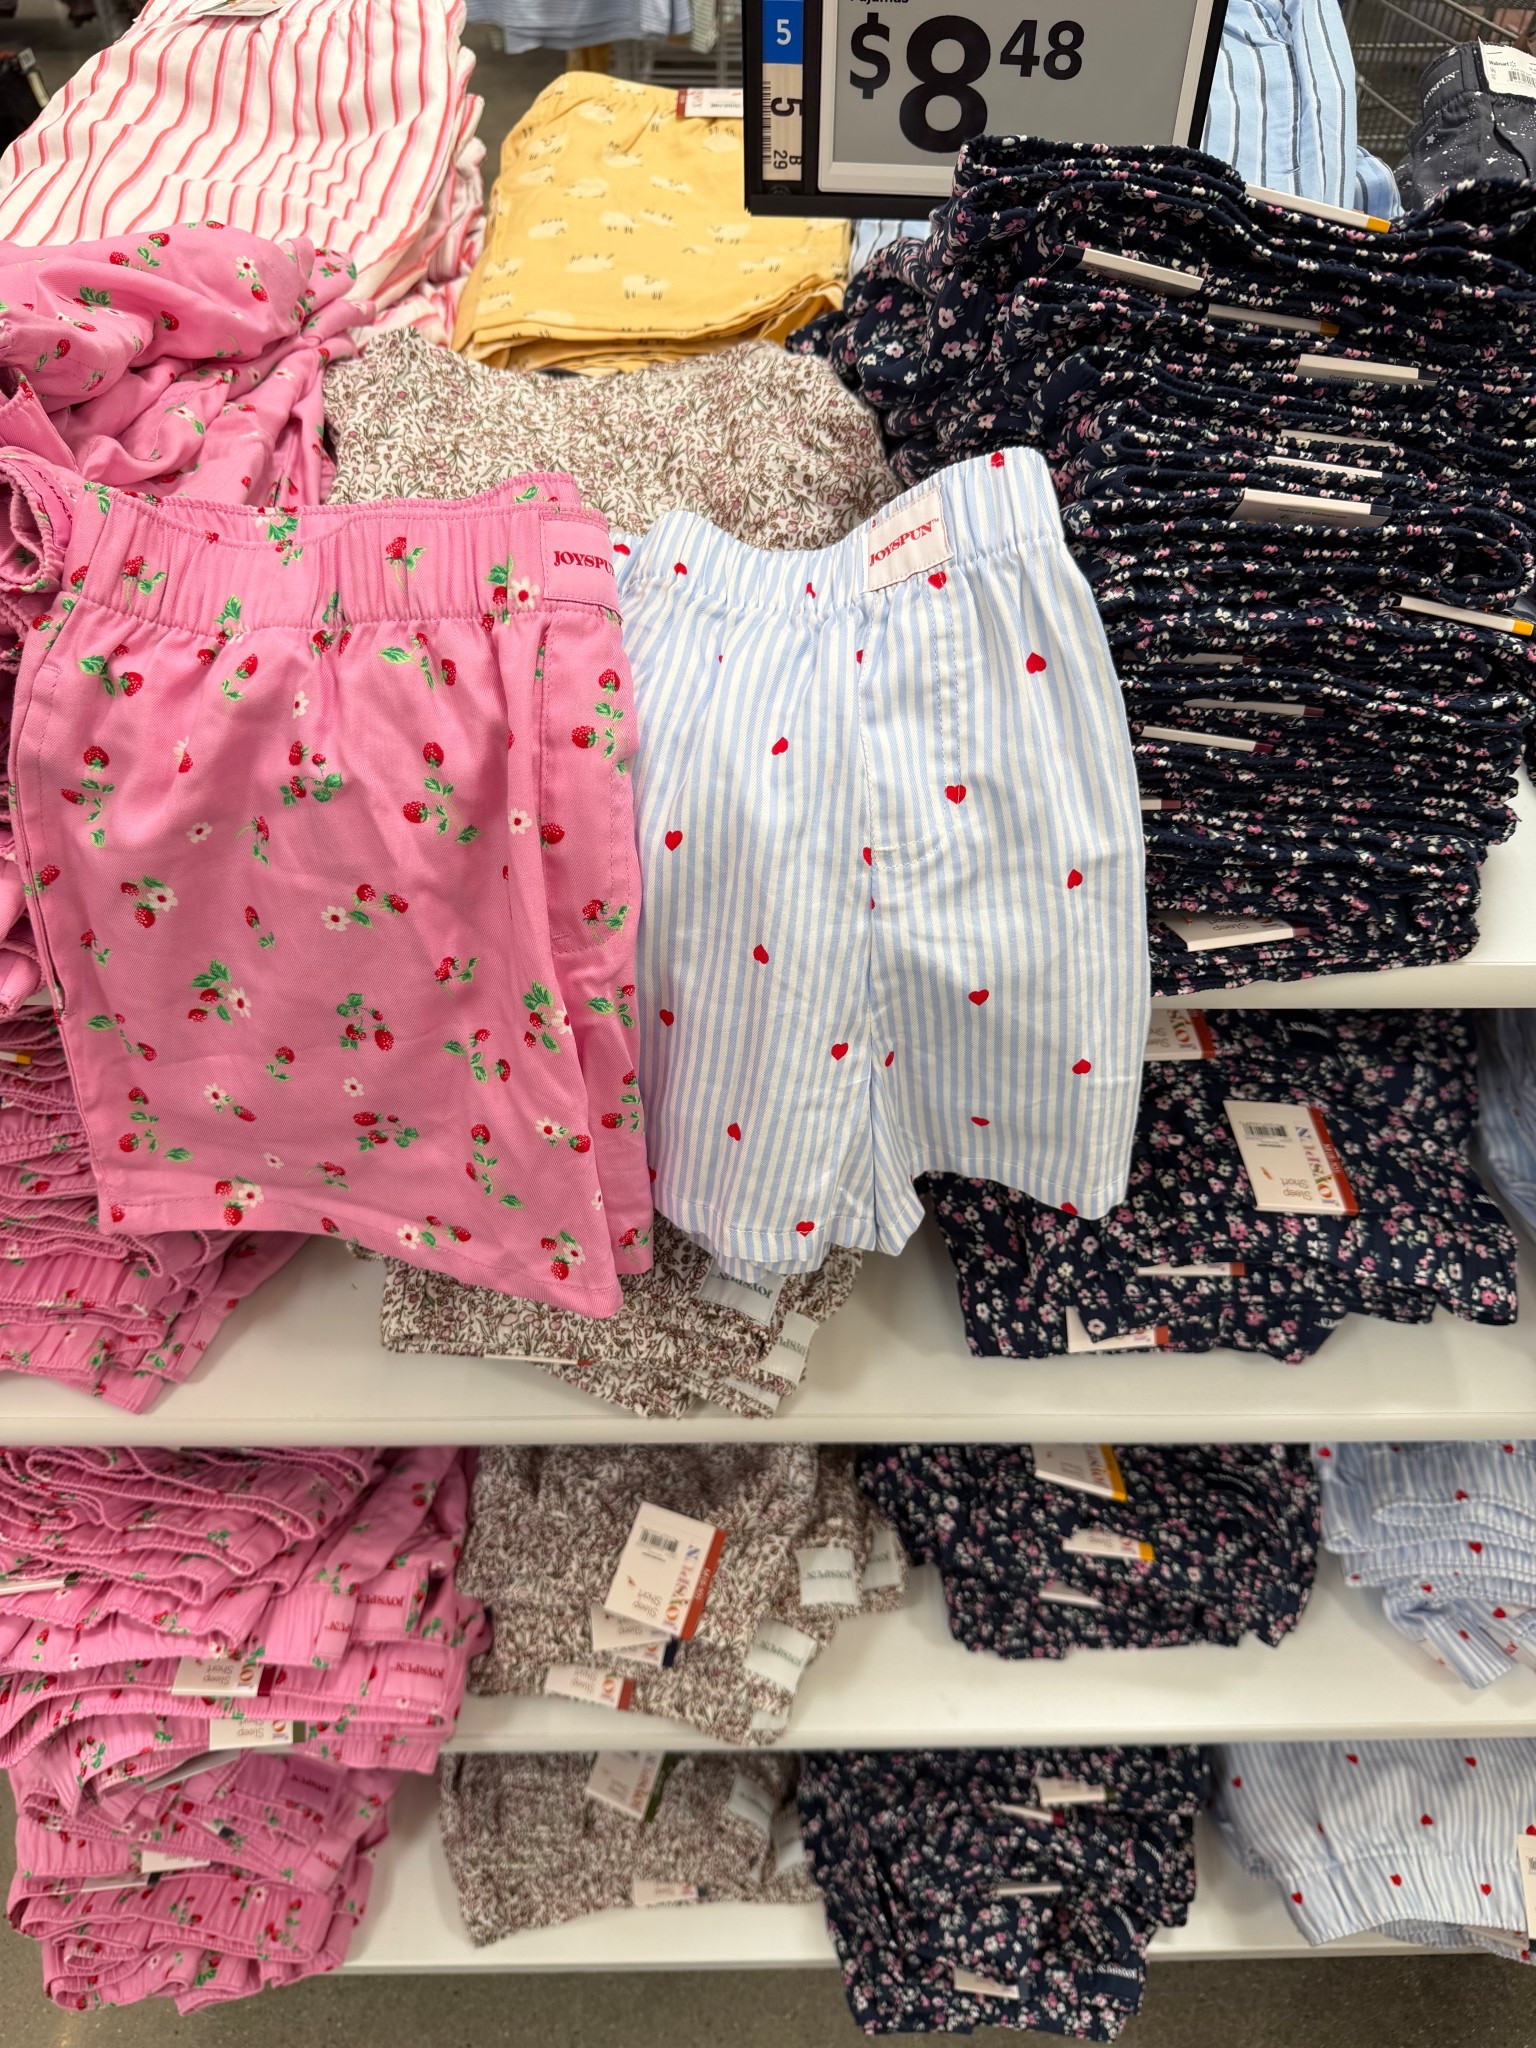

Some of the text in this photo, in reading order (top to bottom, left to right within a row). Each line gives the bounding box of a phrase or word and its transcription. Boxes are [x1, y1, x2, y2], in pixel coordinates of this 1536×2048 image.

[776, 18, 792, 46] 5
[1146, 1038, 1170, 1048] Slee
[1281, 1177, 1309, 1188] Short
[1283, 1188, 1312, 1201] Sleep
[207, 1664, 234, 1674] Short
[203, 1674, 231, 1685] Sleep
[237, 1727, 265, 1738] Sleep
